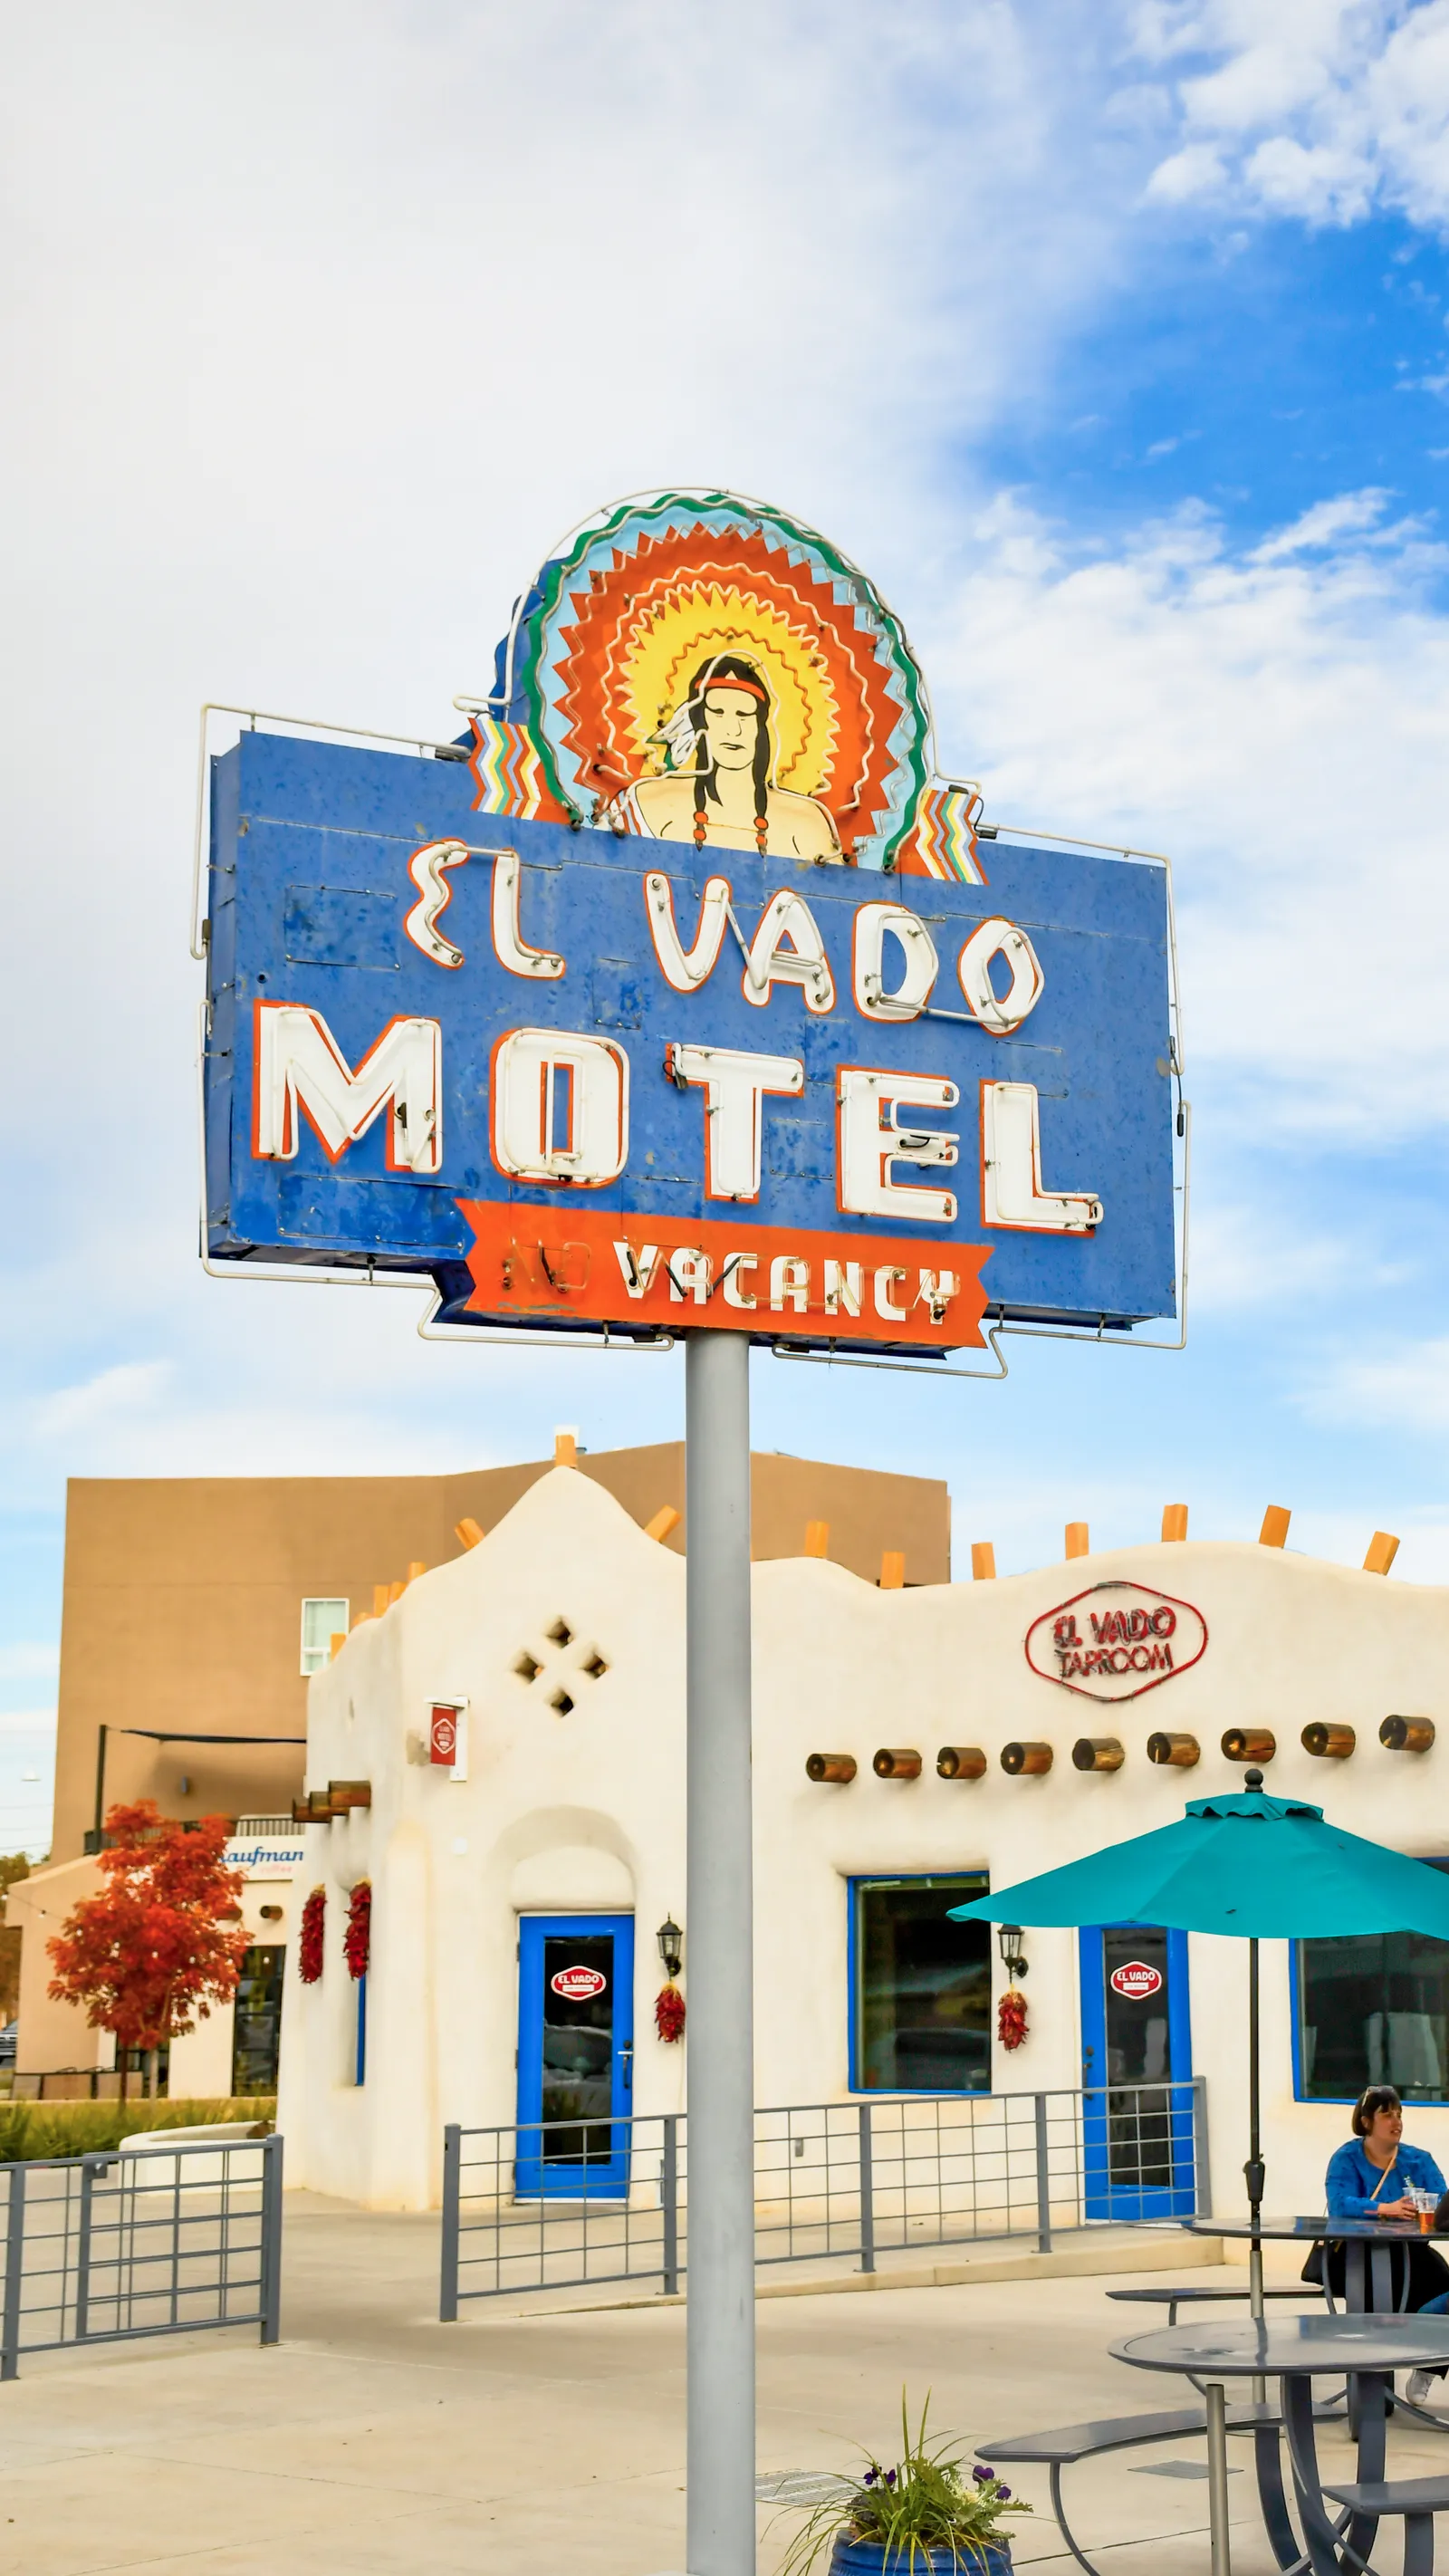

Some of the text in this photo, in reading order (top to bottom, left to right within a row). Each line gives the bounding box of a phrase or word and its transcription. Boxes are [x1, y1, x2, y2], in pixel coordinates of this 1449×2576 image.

[404, 836, 1046, 1037] EL VADO
[252, 998, 1105, 1237] MOTEL
[612, 1240, 961, 1325] VACANCY
[1053, 1605, 1177, 1648] EL VADO
[1054, 1642, 1175, 1678] TAPROOM
[558, 1975, 600, 1984] EL VADO
[1117, 1971, 1156, 1981] EL VADO
